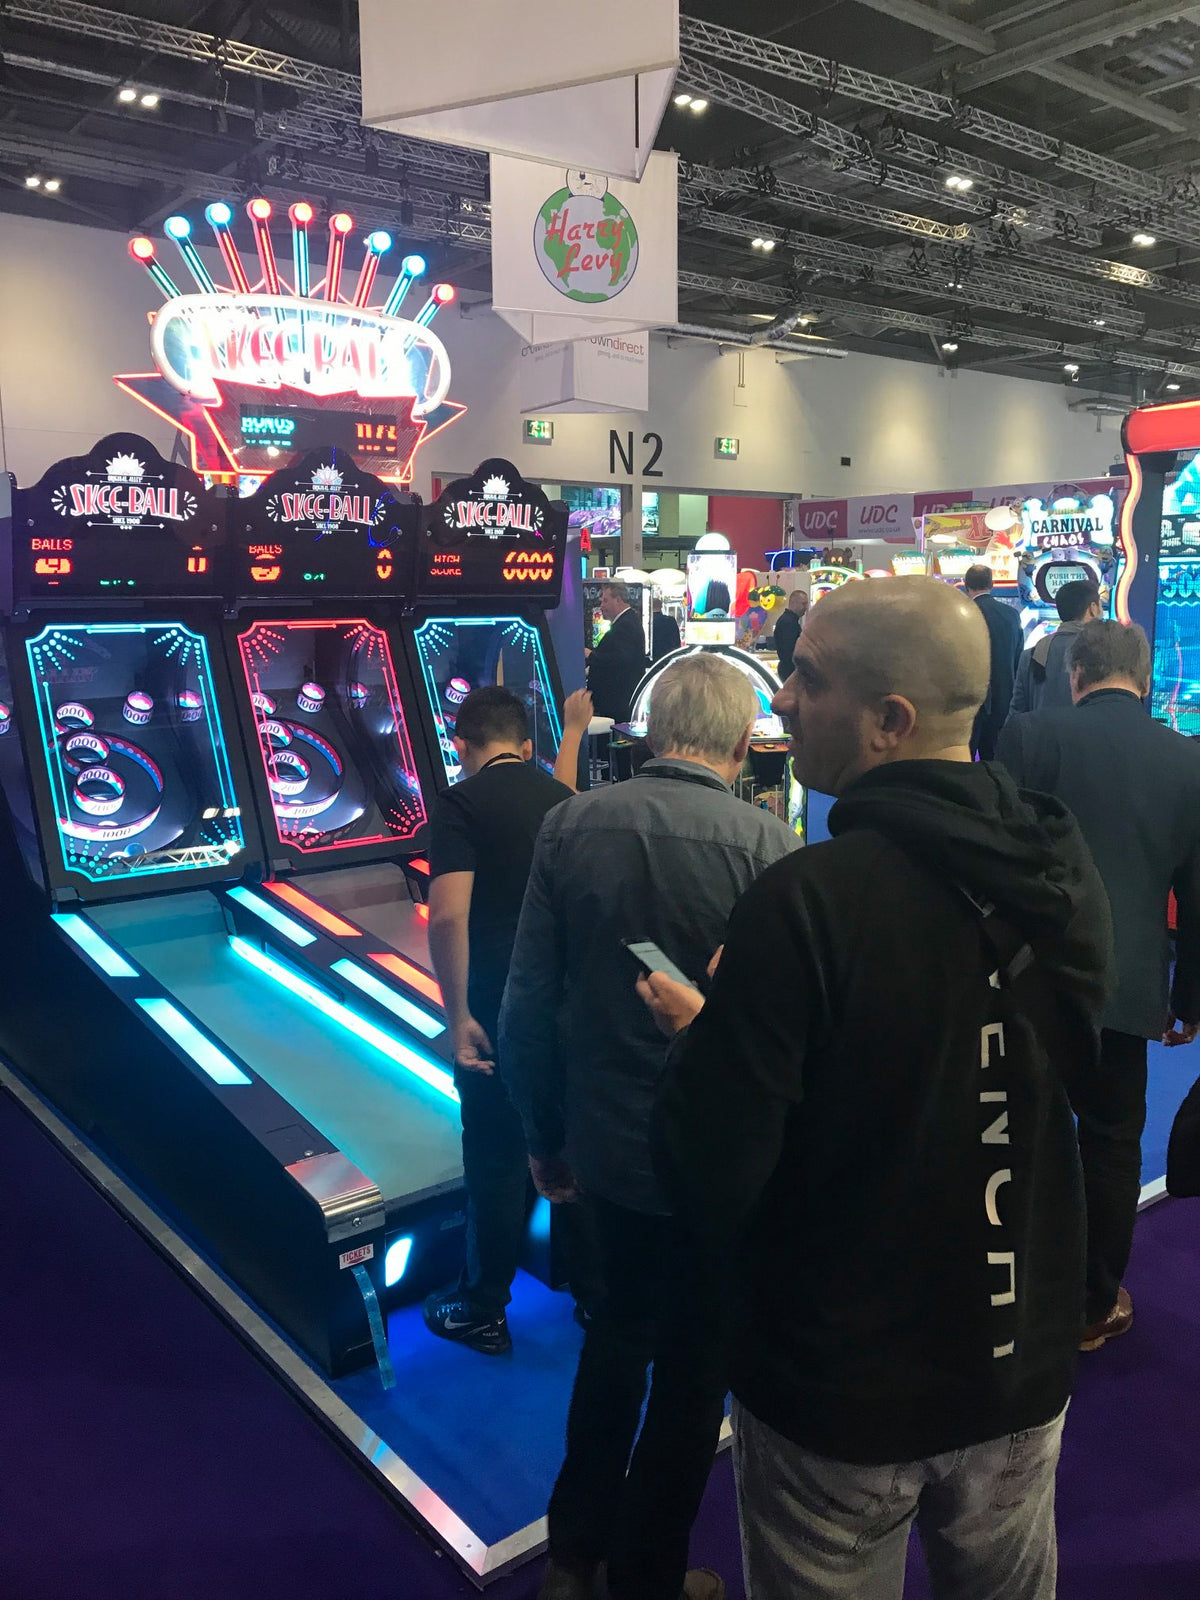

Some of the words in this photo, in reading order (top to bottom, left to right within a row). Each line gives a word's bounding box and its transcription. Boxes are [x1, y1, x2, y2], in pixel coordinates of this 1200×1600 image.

[545, 208, 624, 251] Harry
[557, 243, 623, 282] Levy
[609, 429, 664, 477] N2
[70, 483, 185, 521] SKEE-BALL
[281, 493, 375, 526] SKEE-BALL
[860, 504, 898, 525] UDC
[456, 501, 534, 532] SKEE-BALL
[804, 510, 839, 530] UDC
[1031, 517, 1104, 534] CARNIVAL
[31, 538, 73, 551] BALLS
[1043, 533, 1084, 548] CHAOS
[342, 1246, 371, 1263] TICKETS
